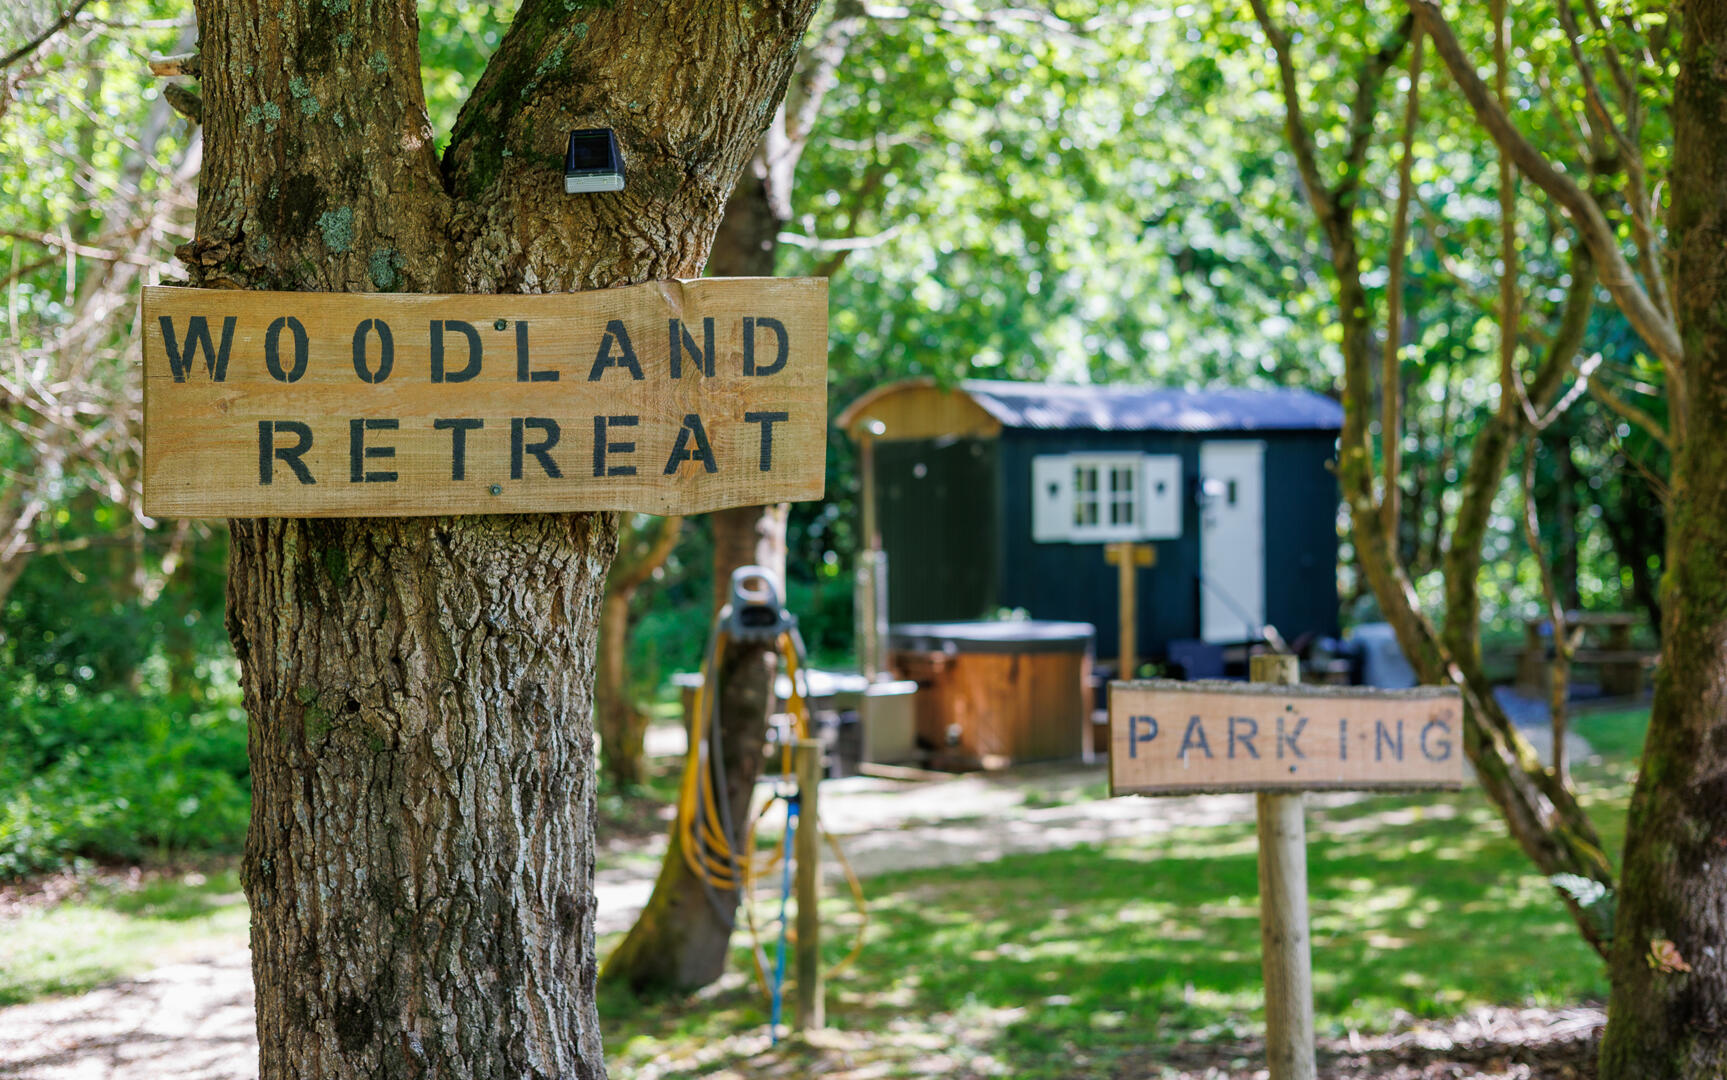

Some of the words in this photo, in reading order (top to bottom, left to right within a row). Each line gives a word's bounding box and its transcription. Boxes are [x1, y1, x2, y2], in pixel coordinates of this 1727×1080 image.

[158, 315, 789, 384] WOODLAND
[258, 411, 789, 485] RETREAT
[1128, 715, 1453, 762] PARKING
